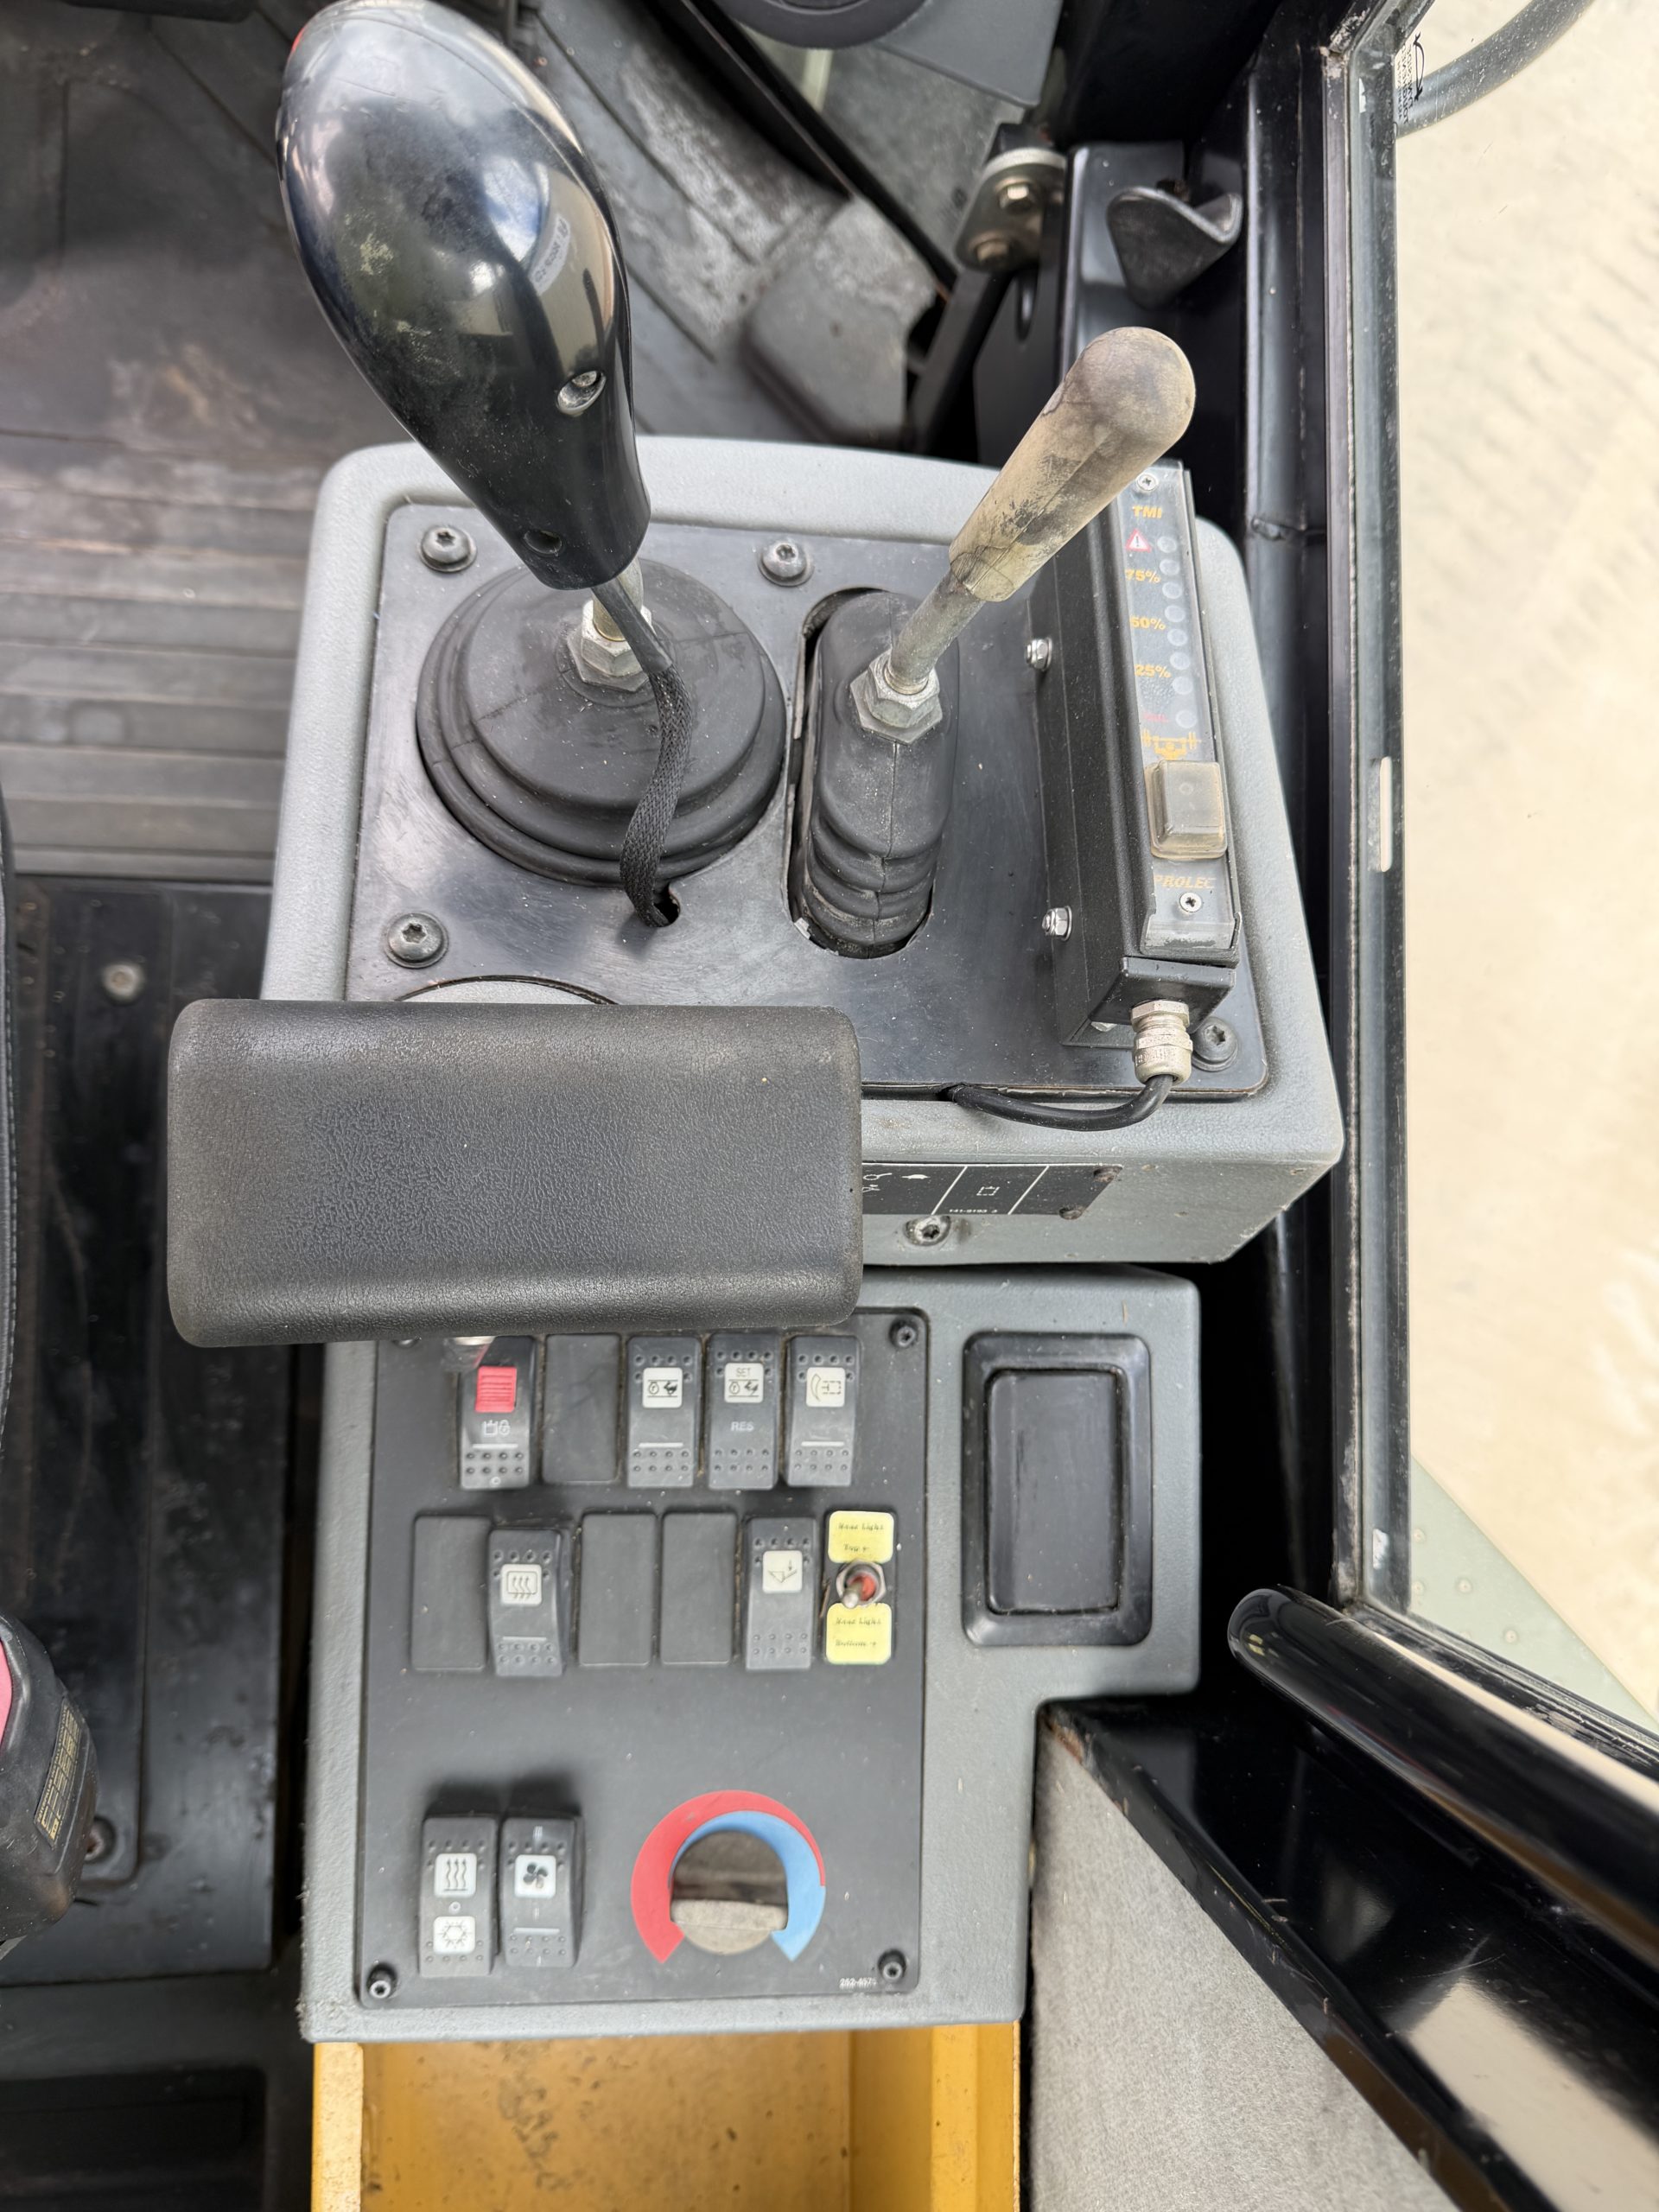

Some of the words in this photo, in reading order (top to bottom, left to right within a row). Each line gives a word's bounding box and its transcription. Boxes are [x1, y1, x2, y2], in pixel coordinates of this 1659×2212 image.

[1132, 505, 1162, 518] TMI
[1125, 569, 1161, 584] 75%
[1129, 615, 1166, 631] 50%
[1134, 663, 1172, 678] 25%
[1154, 874, 1217, 890] PROLEC
[735, 1367, 751, 1377] SET
[730, 1421, 754, 1432] RES
